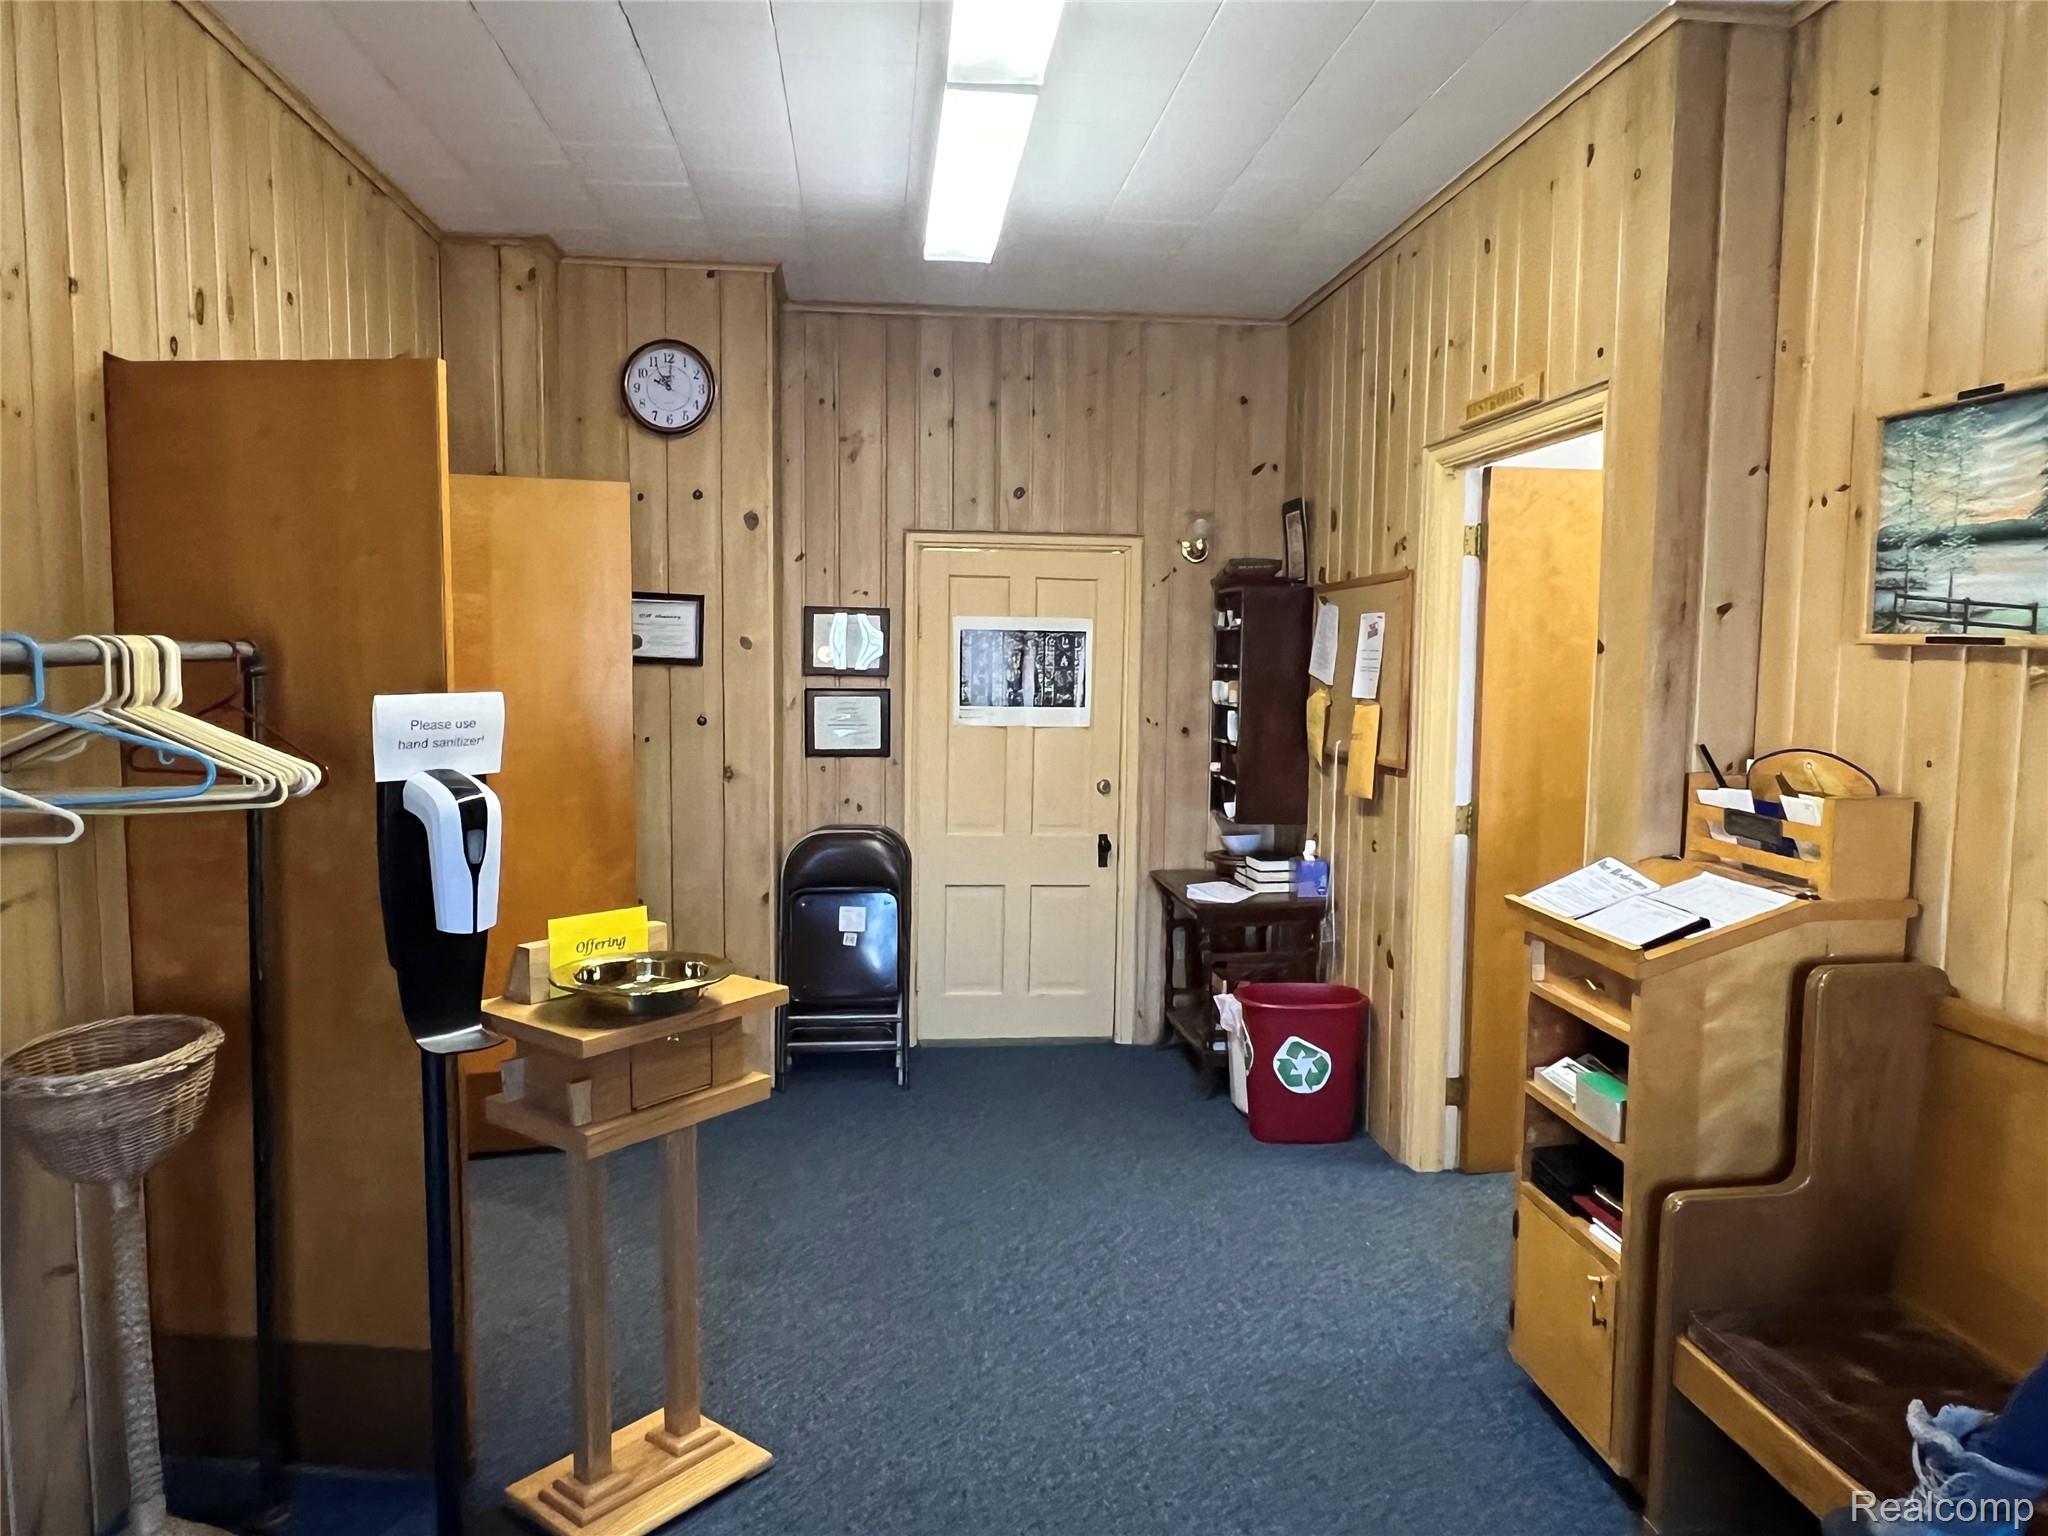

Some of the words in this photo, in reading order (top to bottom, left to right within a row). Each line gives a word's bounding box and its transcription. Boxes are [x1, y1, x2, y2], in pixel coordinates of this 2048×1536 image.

[649, 356, 658, 367] 11
[663, 353, 675, 364] 12
[638, 368, 648, 378] 10
[693, 369, 700, 380] 2
[633, 383, 641, 393] 9
[698, 384, 705, 395] 3
[652, 410, 658, 421] 7
[666, 414, 673, 425] 6
[683, 410, 689, 421] 5
[410, 719, 452, 731] Please
[455, 719, 477, 729] use
[398, 738, 428, 750] hand
[576, 936, 627, 957] Offering
